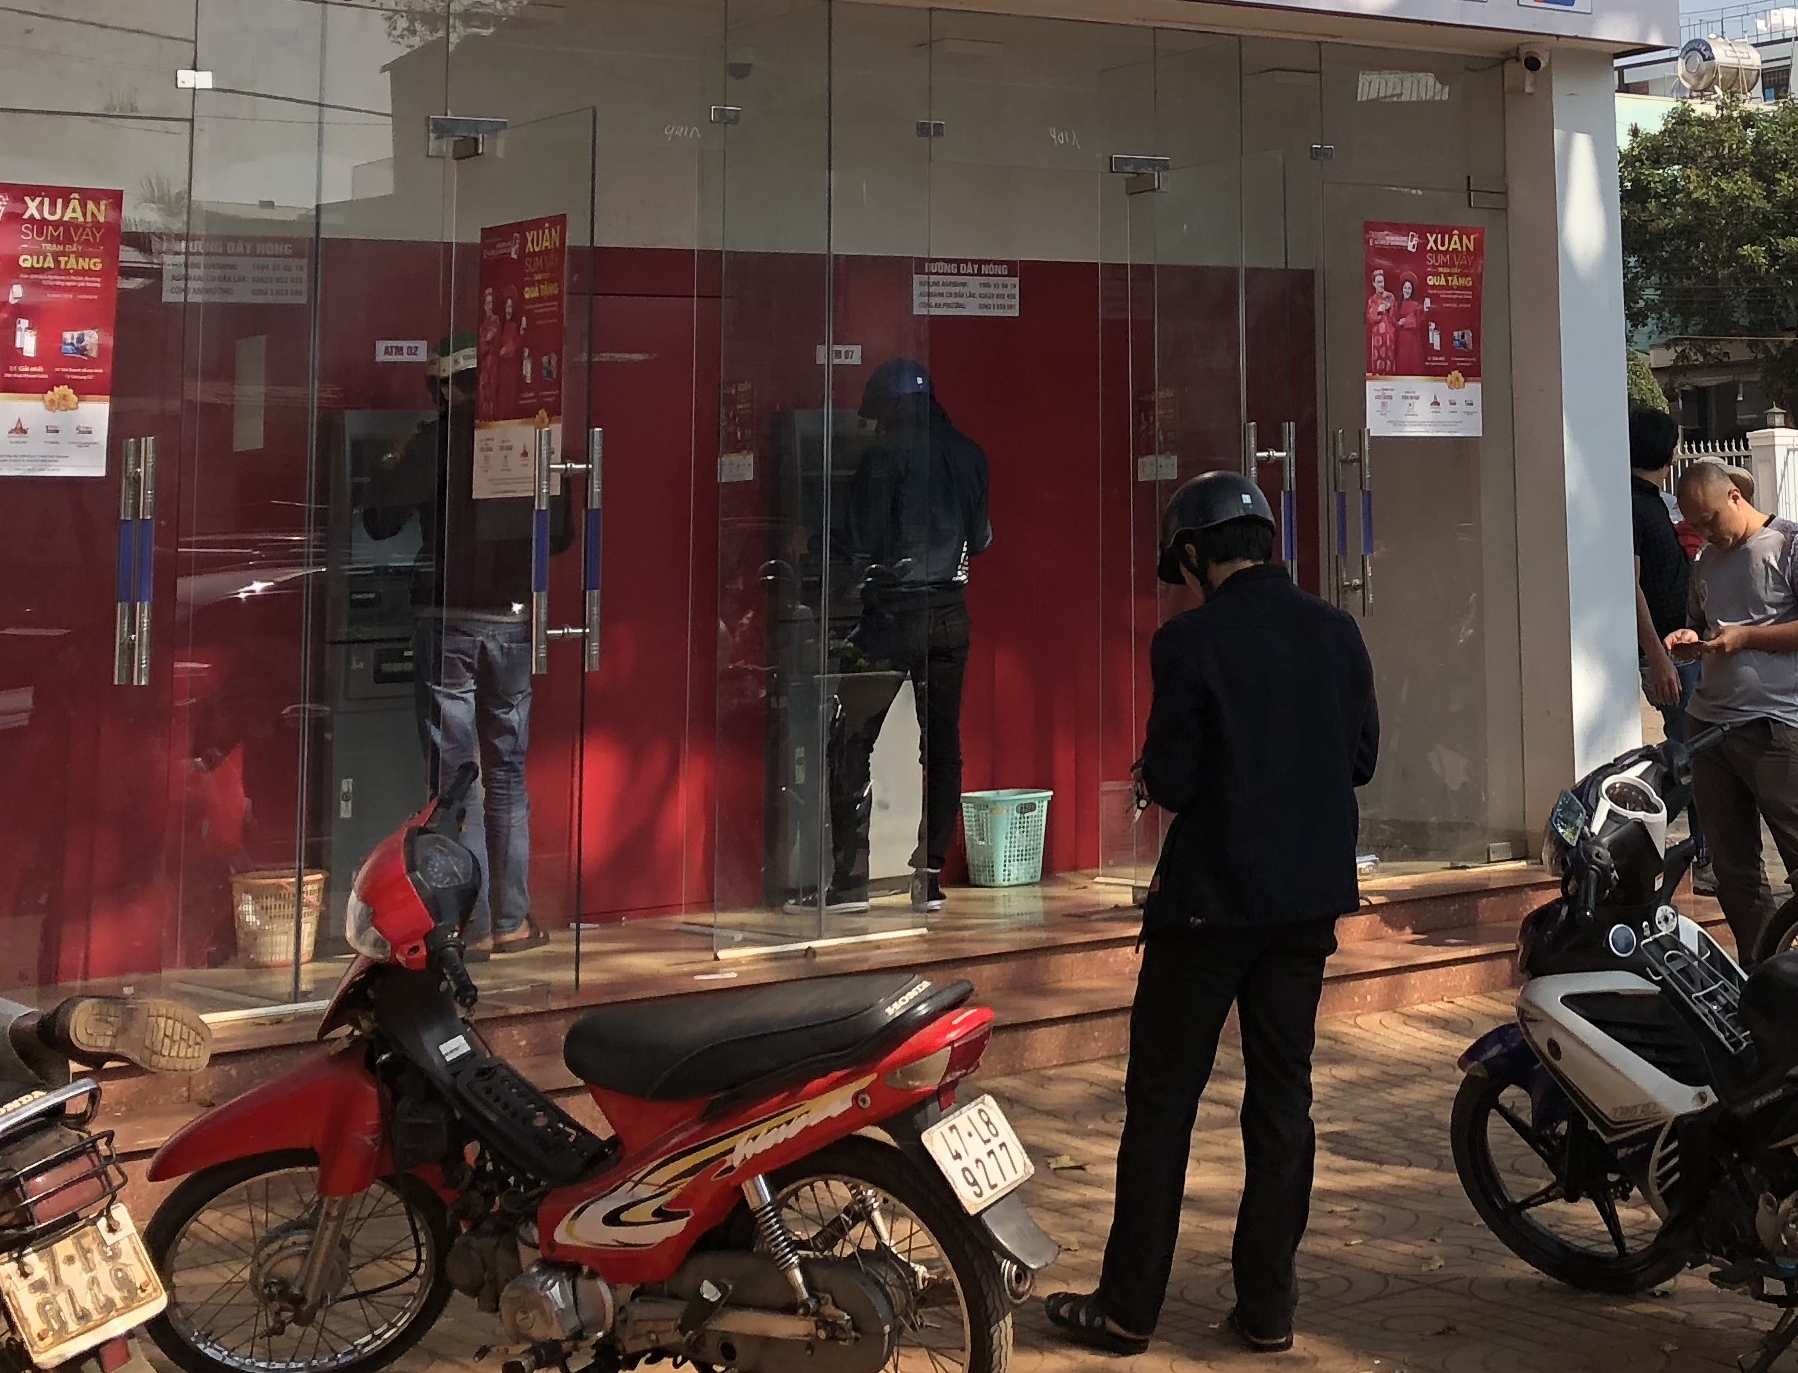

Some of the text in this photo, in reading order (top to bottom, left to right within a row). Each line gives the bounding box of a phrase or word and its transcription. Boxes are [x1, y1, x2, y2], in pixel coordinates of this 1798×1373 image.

[22, 192, 106, 223] XUÂN
[21, 224, 63, 241] SUM
[526, 223, 560, 252] XUÂN
[1426, 229, 1474, 252] XUÂN
[19, 253, 102, 273] QUÀ TẶNG
[960, 261, 979, 274] DÂY
[981, 263, 1008, 275] NÓNG
[1426, 253, 1450, 266] SUM
[1426, 274, 1473, 289] QUÀ TẶNG
[885, 980, 932, 1017] HONDA
[961, 1141, 1018, 1198] 9277
